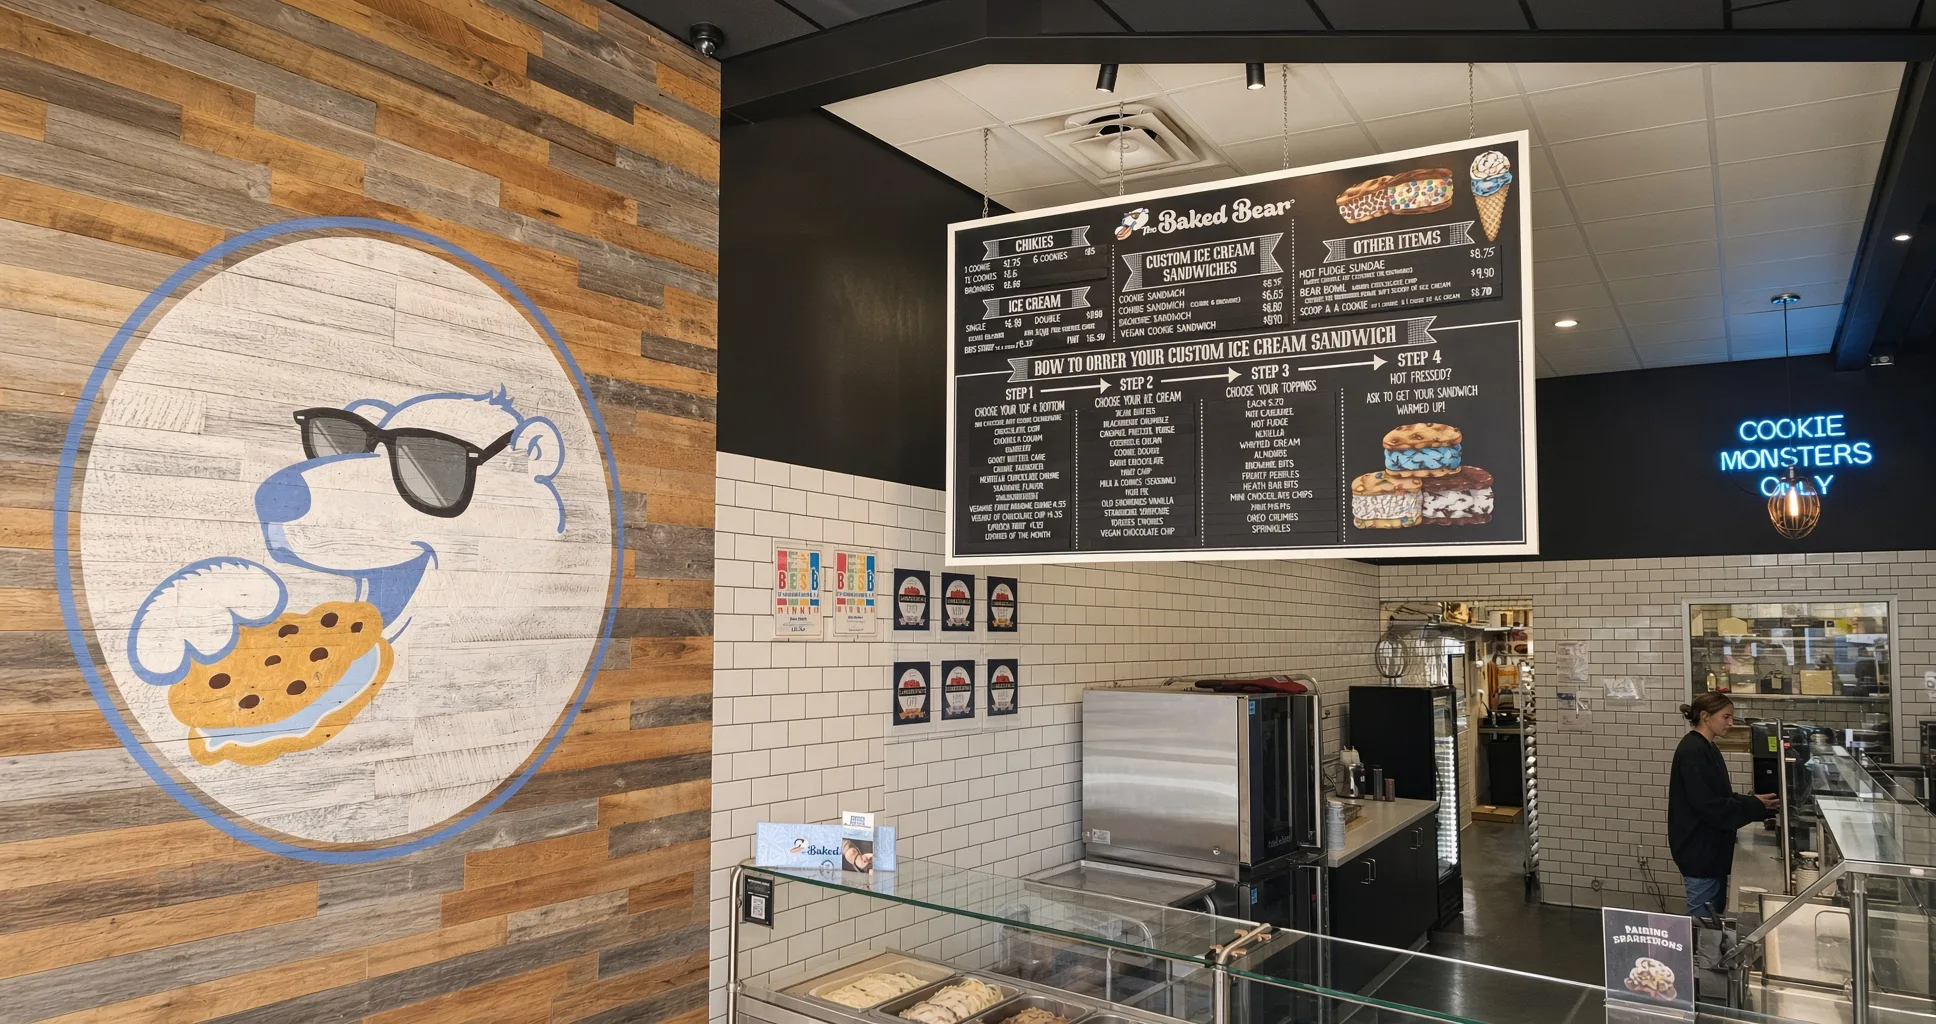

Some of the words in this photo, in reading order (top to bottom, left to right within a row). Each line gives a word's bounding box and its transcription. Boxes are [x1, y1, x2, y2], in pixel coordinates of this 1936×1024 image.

[1158, 205, 1228, 234] Baked
[1353, 234, 1394, 255] OTHER
[1398, 230, 1442, 250] ITEMS
[1146, 251, 1193, 269] CUSTOM
[1194, 248, 1211, 264] ICE
[1213, 241, 1255, 261] CREAM
[1470, 246, 1496, 260] $8.75
[1163, 260, 1238, 282] SANDWICHES
[1299, 267, 1316, 280] HOT
[1318, 264, 1346, 278] FUDGE
[1349, 259, 1386, 272] SUNDAE
[1470, 267, 1495, 279] $9.90
[1008, 298, 1024, 314] ICE
[1025, 294, 1062, 311] CREAM
[1341, 300, 1369, 311] COOKIE
[1176, 320, 1216, 333] SANDWICH
[1067, 356, 1084, 374] TO
[1130, 351, 1166, 369] YOUR
[1168, 342, 1224, 366] CUSTOM
[1228, 340, 1252, 359] ICE
[1253, 333, 1308, 357] CREAM
[1310, 324, 1397, 351] SANDWICH
[1397, 350, 1429, 368] STEP
[1432, 349, 1442, 364] 4
[1251, 364, 1280, 380] STEP
[1282, 363, 1290, 378] 3
[1390, 372, 1407, 385] HOT
[1120, 376, 1145, 391] STEP
[1146, 376, 1154, 389] 2
[1226, 384, 1255, 398] CHOOSE
[1257, 382, 1279, 395] YOUR
[1281, 379, 1318, 393] TOPPINGS
[1005, 388, 1028, 402] STEP
[1029, 386, 1034, 399] 1
[1156, 390, 1182, 403] CREAM
[1366, 392, 1381, 404] ASK
[1383, 391, 1393, 402] TO
[1395, 389, 1411, 401] GET
[1413, 388, 1435, 400] YOUR
[1437, 384, 1479, 399] SANDWICH
[1396, 402, 1430, 416] WARMED
[1432, 400, 1446, 413] UP!
[1739, 414, 1846, 441] COOKIE
[1273, 438, 1301, 448] CREAM
[1720, 441, 1873, 471] MONSTERS
